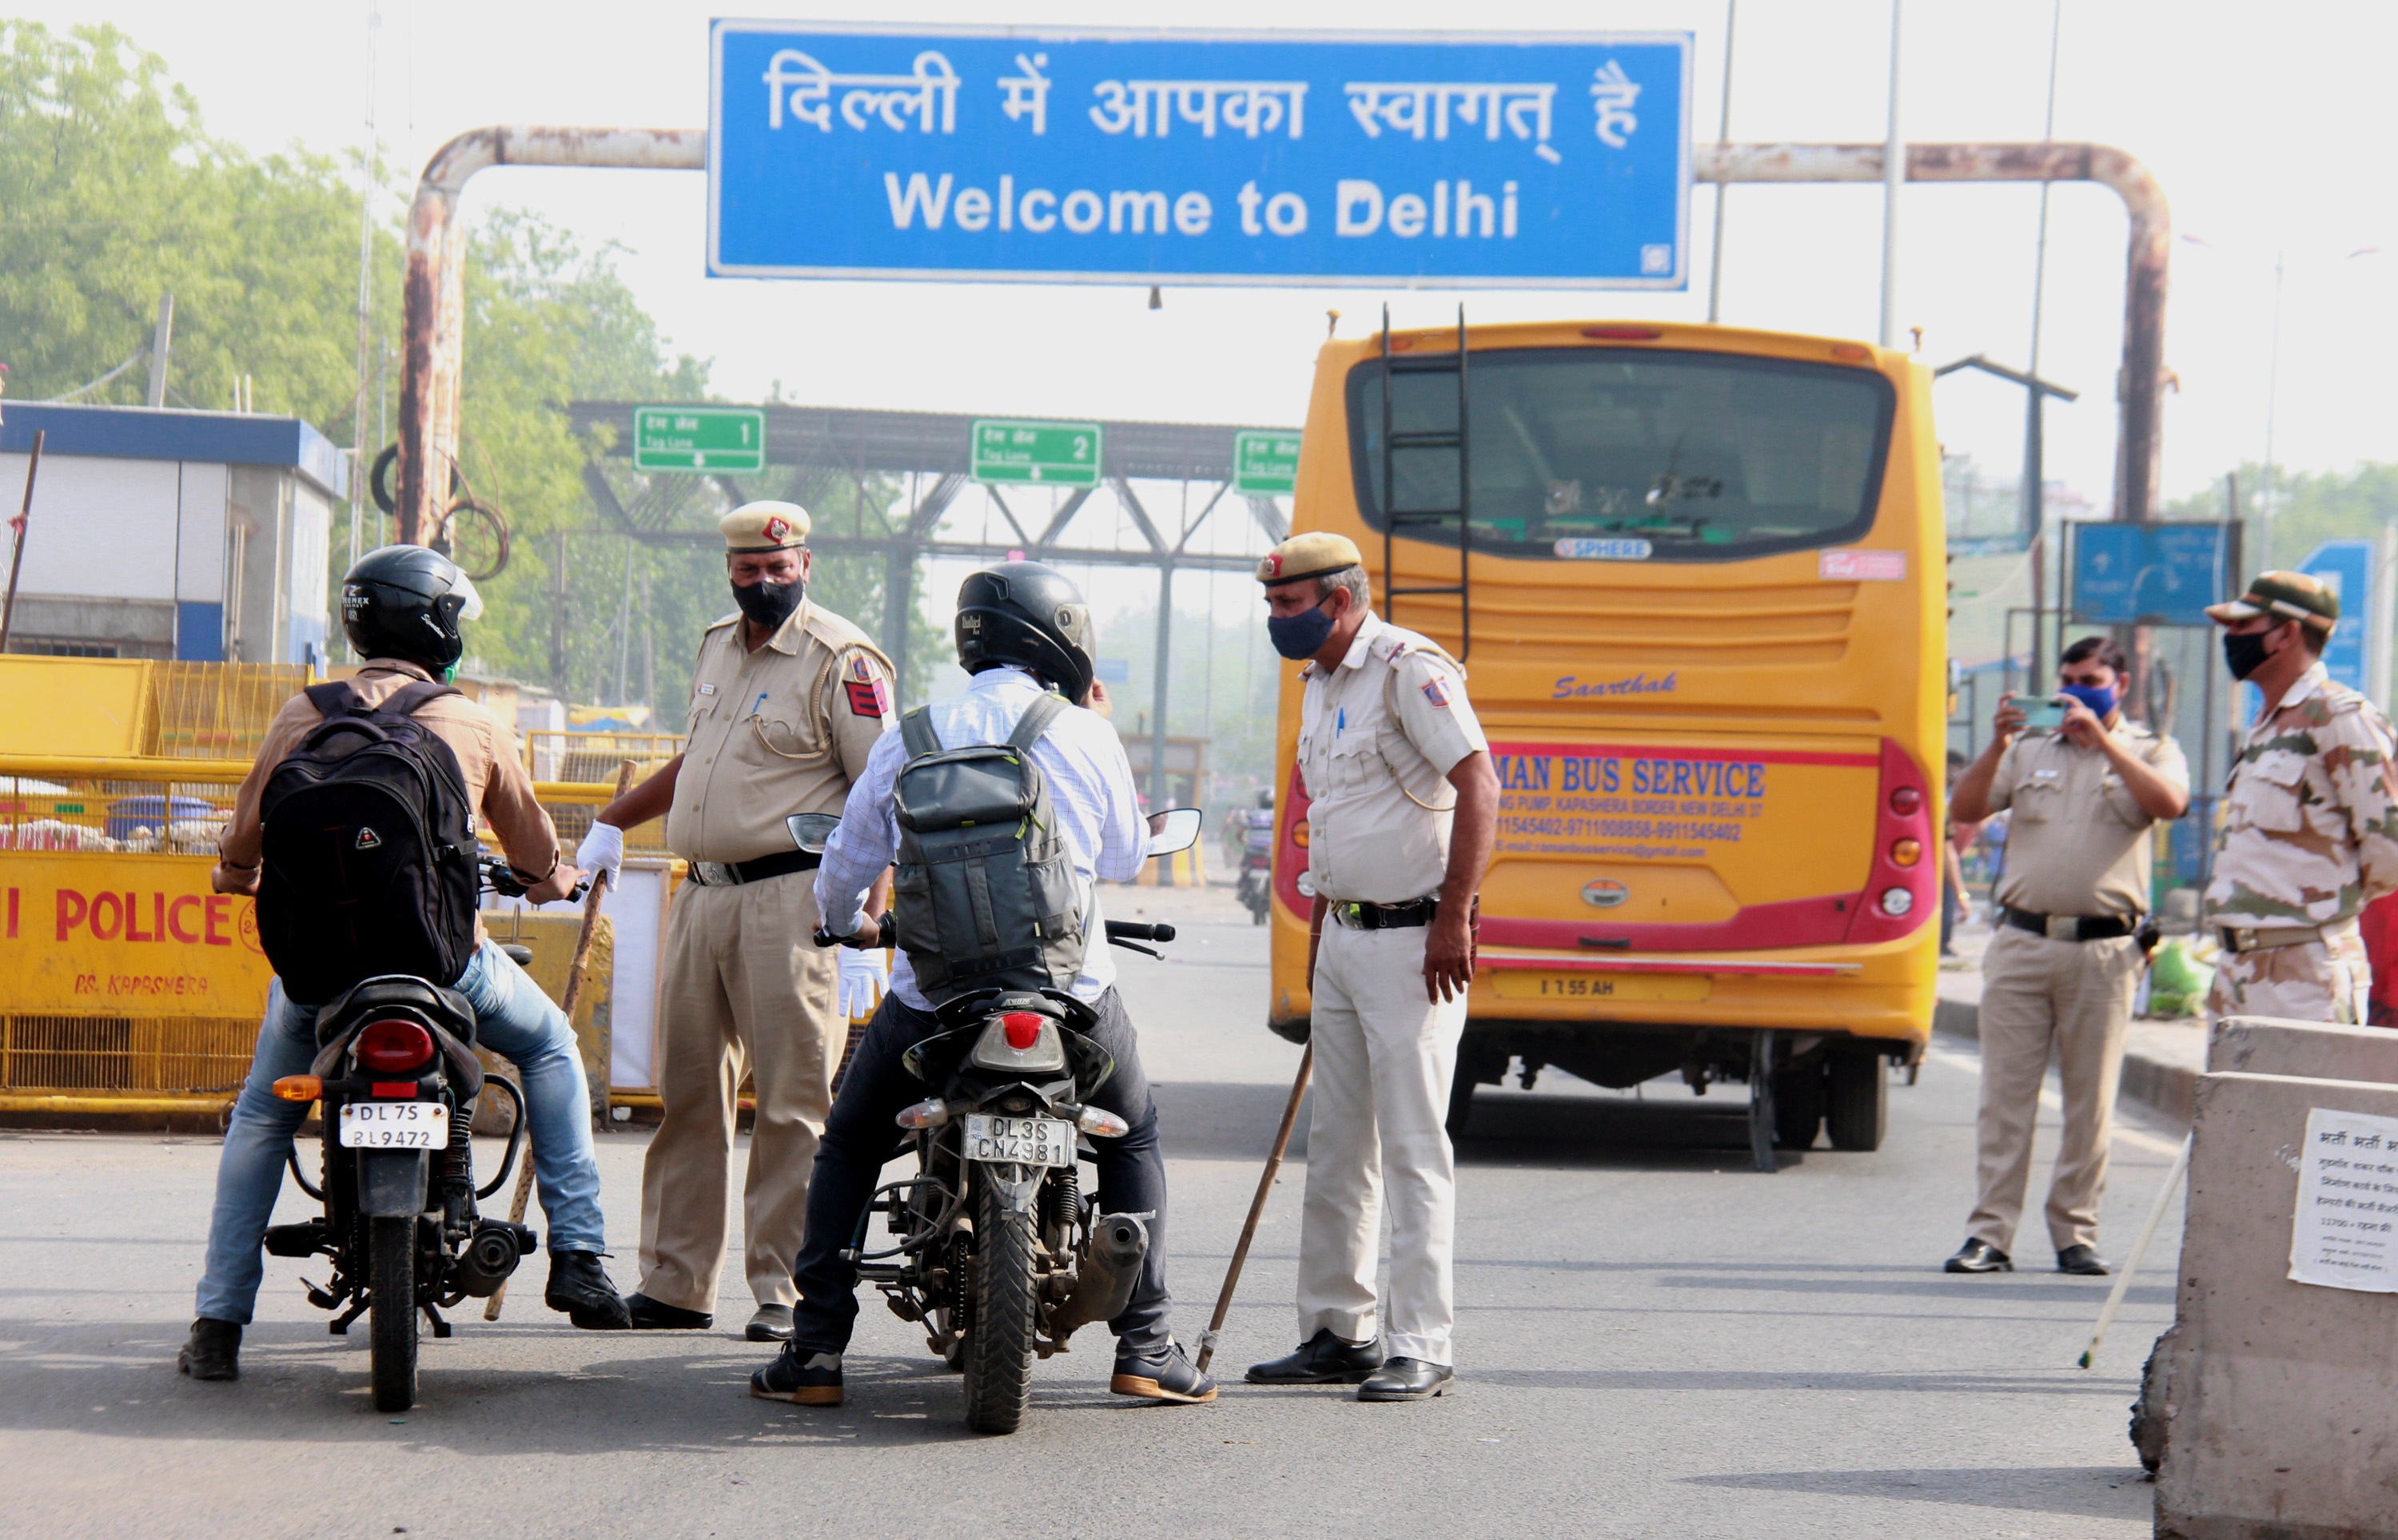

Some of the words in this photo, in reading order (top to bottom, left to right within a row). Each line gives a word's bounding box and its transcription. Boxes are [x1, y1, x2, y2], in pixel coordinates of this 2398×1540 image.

[762, 48, 962, 133] दिल्ली
[997, 53, 1051, 135] में
[1088, 78, 1309, 138] आपका
[1589, 58, 1643, 149] है
[883, 170, 1213, 237] Welcome
[1240, 180, 1309, 238] to
[1335, 178, 1520, 240] Delhi
[740, 421, 750, 446] 1
[1073, 436, 1089, 460] 2
[1574, 540, 1646, 557] SPHERE
[1552, 671, 1677, 698] Saarthak
[1561, 757, 1620, 793] BUS
[1632, 760, 1766, 798] SERVICE
[56, 889, 232, 945] POLICE
